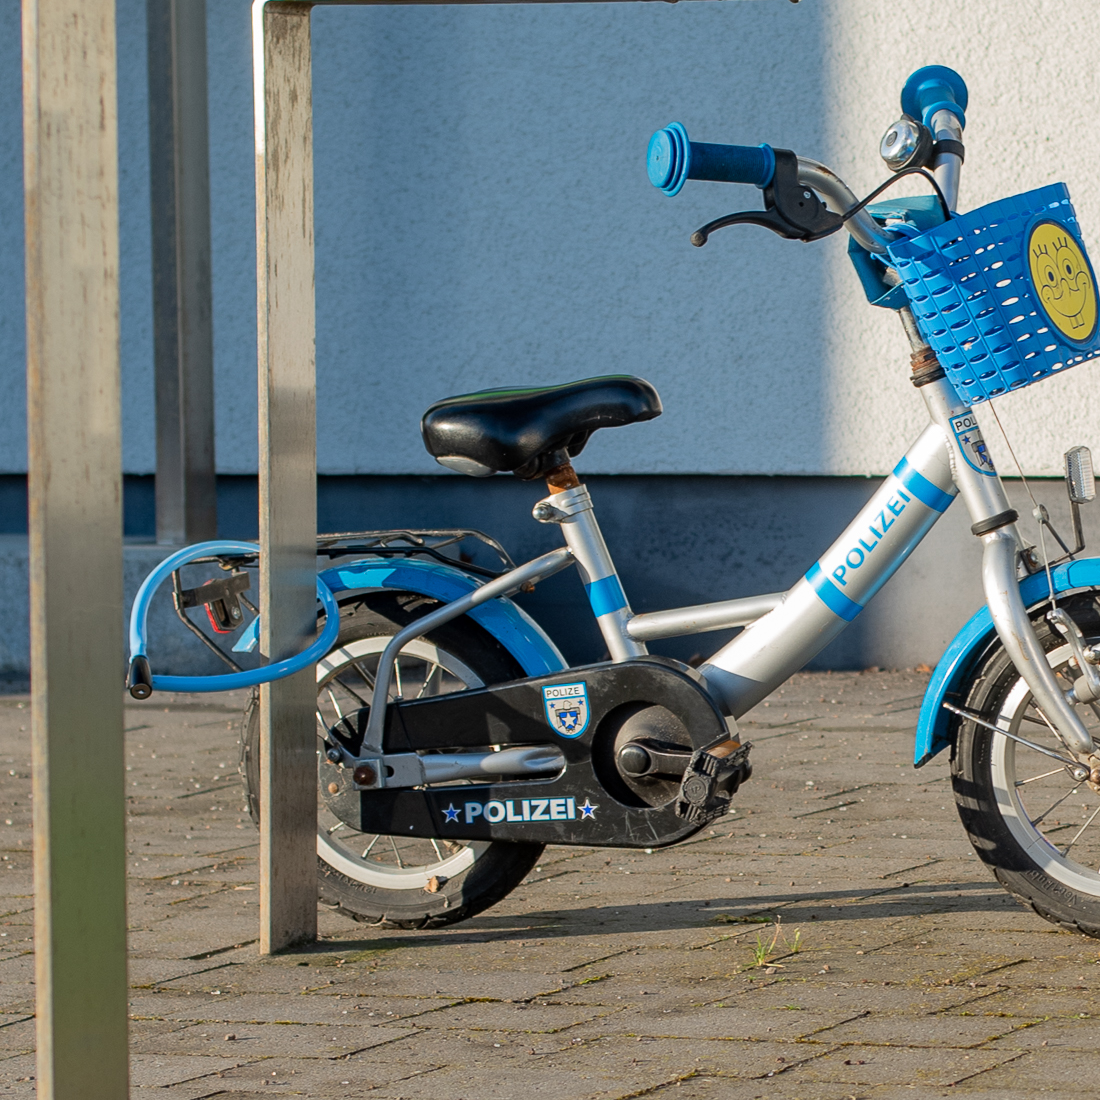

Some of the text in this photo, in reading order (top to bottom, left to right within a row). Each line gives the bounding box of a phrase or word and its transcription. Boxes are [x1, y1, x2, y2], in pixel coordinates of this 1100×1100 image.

[955, 416, 977, 431] POL
[832, 489, 911, 587] POLIZEI
[546, 686, 580, 697] POLIZE
[464, 797, 576, 824] POLIZEI
